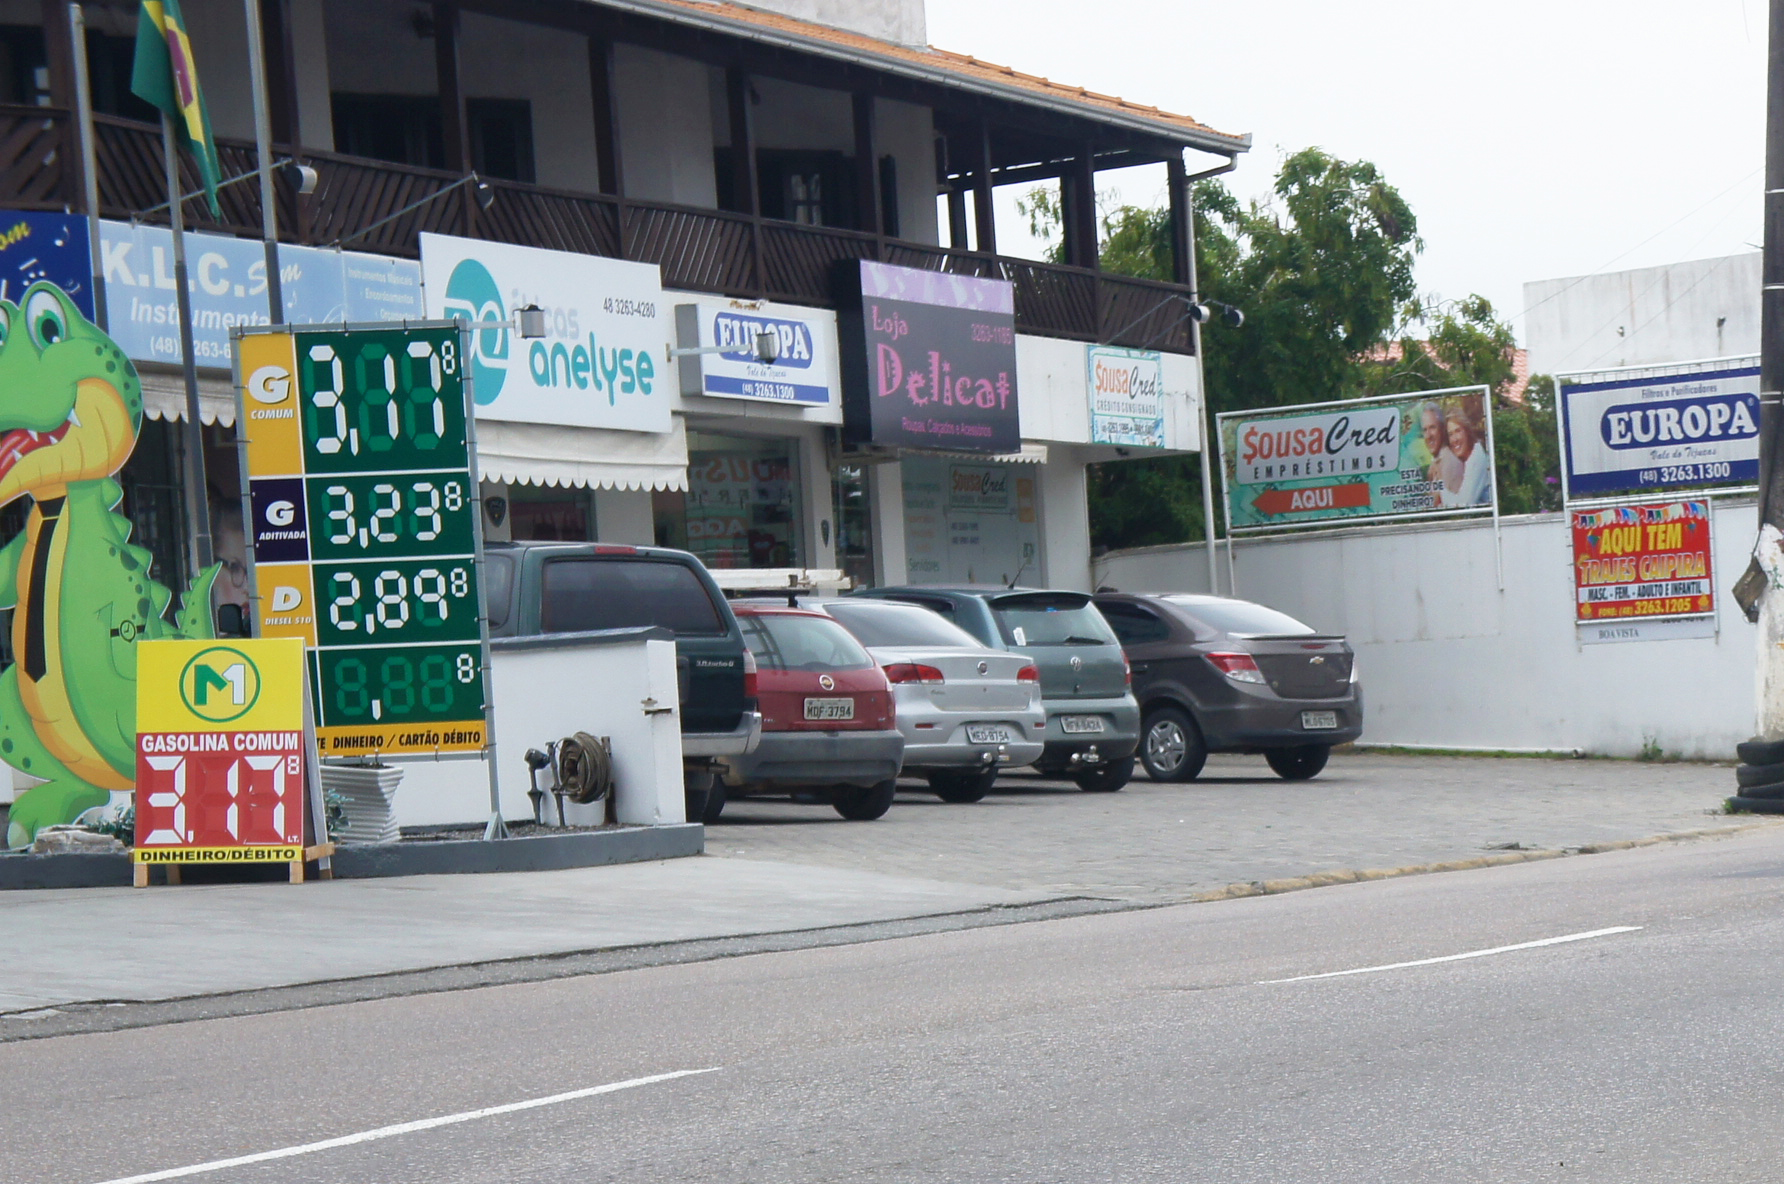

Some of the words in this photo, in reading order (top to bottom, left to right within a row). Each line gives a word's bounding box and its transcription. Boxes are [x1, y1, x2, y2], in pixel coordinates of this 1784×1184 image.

[248, 260, 302, 297] Sm
[603, 298, 613, 313] 48
[615, 299, 656, 319] 3263-4280
[872, 305, 908, 340] Loja
[150, 336, 180, 357] (48)
[529, 331, 654, 406] anelyse
[876, 342, 1011, 410] Delicat
[248, 365, 290, 404] G
[755, 383, 795, 399] 3263.1300
[1641, 386, 1661, 399] Filtros
[1671, 384, 1717, 397] Purificadores
[251, 409, 294, 419] COMUM
[1608, 401, 1757, 445] EUROPA
[1650, 449, 1670, 460] Vale
[1672, 448, 1682, 459] do
[1254, 455, 1386, 480] EMPRÉSTIMOS
[1639, 471, 1657, 484] (48)
[1661, 463, 1730, 483] 3263.1300
[1291, 488, 1333, 509] AQUI
[1380, 482, 1430, 496] PRECISANDO
[1433, 480, 1444, 491] DE
[265, 500, 294, 526] G
[1392, 497, 1433, 509] DINHEIRO?
[326, 482, 442, 548] 3,23
[259, 531, 306, 541] ADITIVADA
[1600, 526, 1641, 556] AQUI
[1646, 523, 1682, 550] TEM
[1579, 557, 1637, 585] TRAJES
[1639, 551, 1706, 581] CAIPIRA
[272, 586, 302, 612] D
[329, 568, 448, 635] 2,89
[1588, 587, 1608, 601] MASC.
[1615, 586, 1630, 599] FEM.
[1637, 584, 1663, 598] ADULTO
[1665, 585, 1669, 596] E
[1671, 581, 1702, 596] INFANTIL
[1635, 598, 1692, 614] 3263.1205
[265, 617, 292, 625] DIESEL
[1615, 628, 1639, 638] VISTA
[142, 734, 229, 752] GASOLINA
[233, 733, 298, 751] COMUM
[333, 735, 384, 749] DINHEIRO
[399, 730, 439, 746] CARTÃO
[443, 728, 481, 745] DÉBITO
[140, 847, 295, 861] DINHEIRO/DÉBITO
